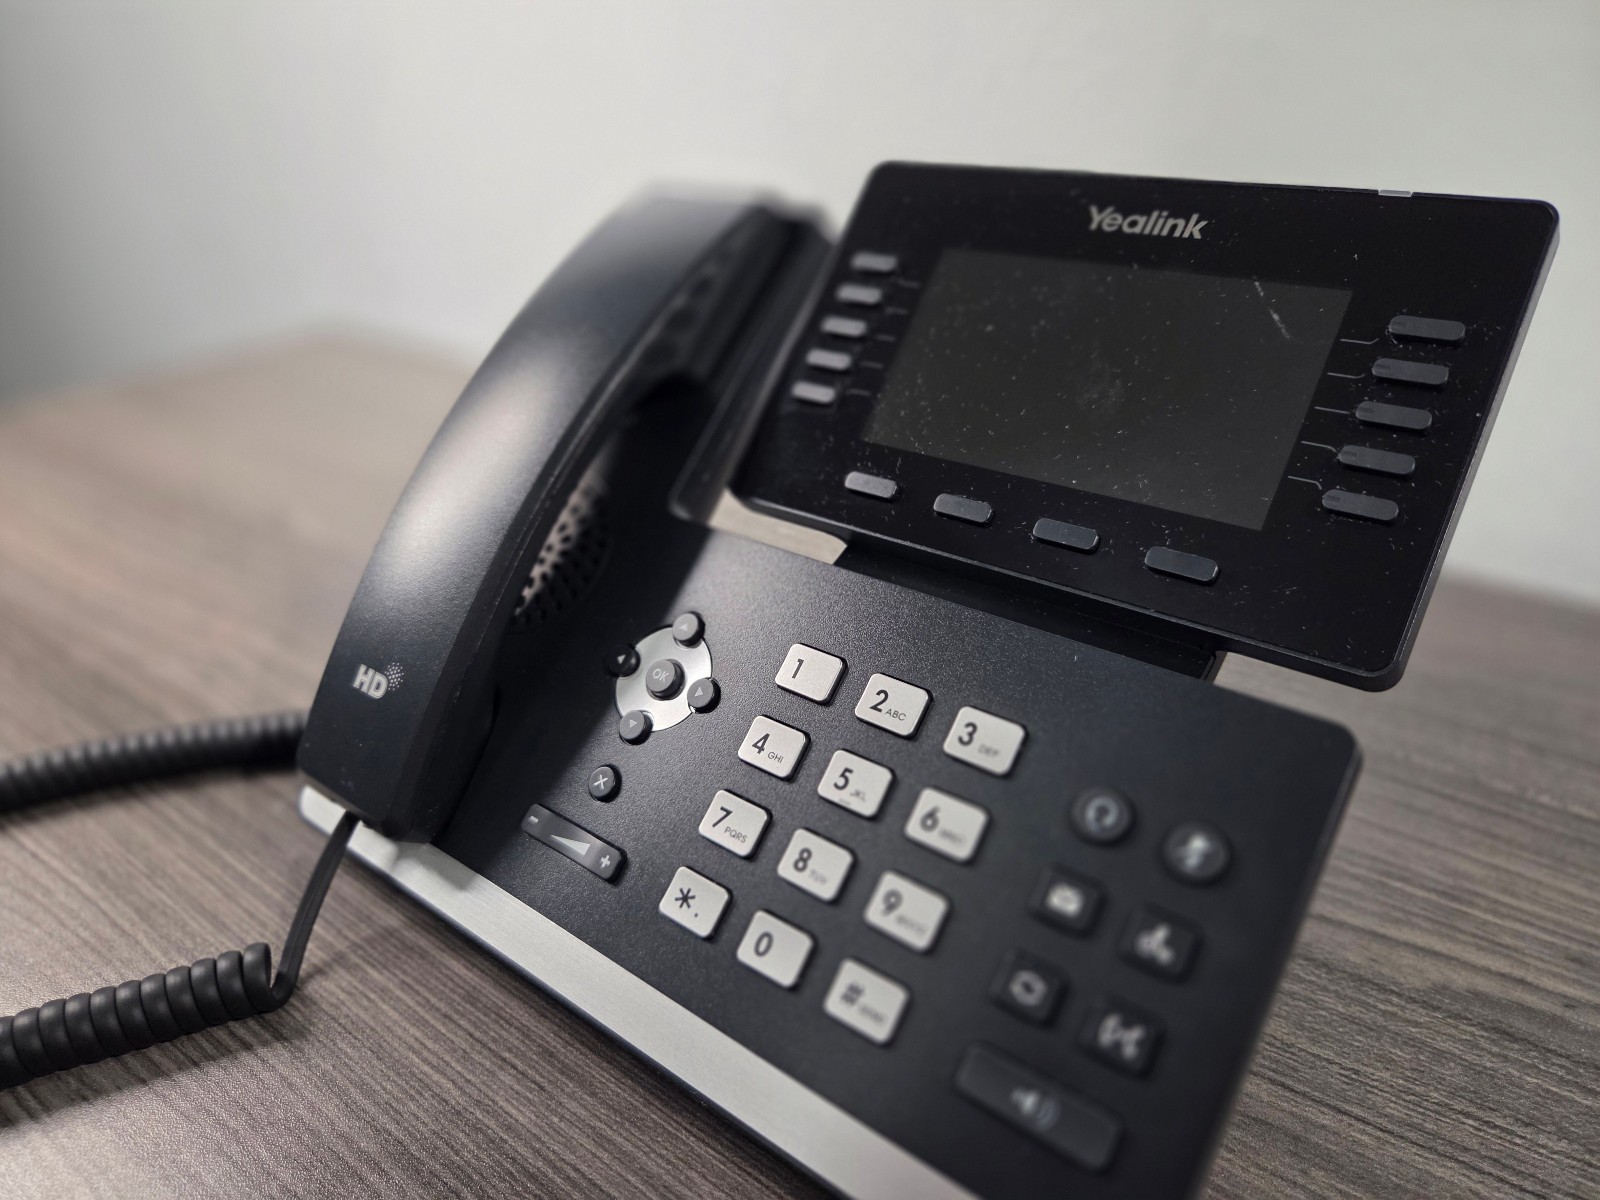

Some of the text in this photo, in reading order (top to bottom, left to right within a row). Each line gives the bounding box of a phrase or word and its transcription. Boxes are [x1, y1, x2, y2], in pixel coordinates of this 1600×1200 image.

[1089, 204, 1208, 239] Yealink
[353, 663, 388, 699] HD
[652, 668, 670, 683] OK
[791, 659, 804, 679] 1
[869, 689, 907, 721] 2 ABC
[957, 722, 977, 746] 3
[751, 733, 784, 764] 4 GHI
[833, 767, 853, 790] 5
[711, 806, 747, 843] 7 PQRS
[920, 805, 940, 832] 6
[793, 847, 812, 872] 8
[882, 889, 903, 916] 9
[754, 931, 773, 957] 0
